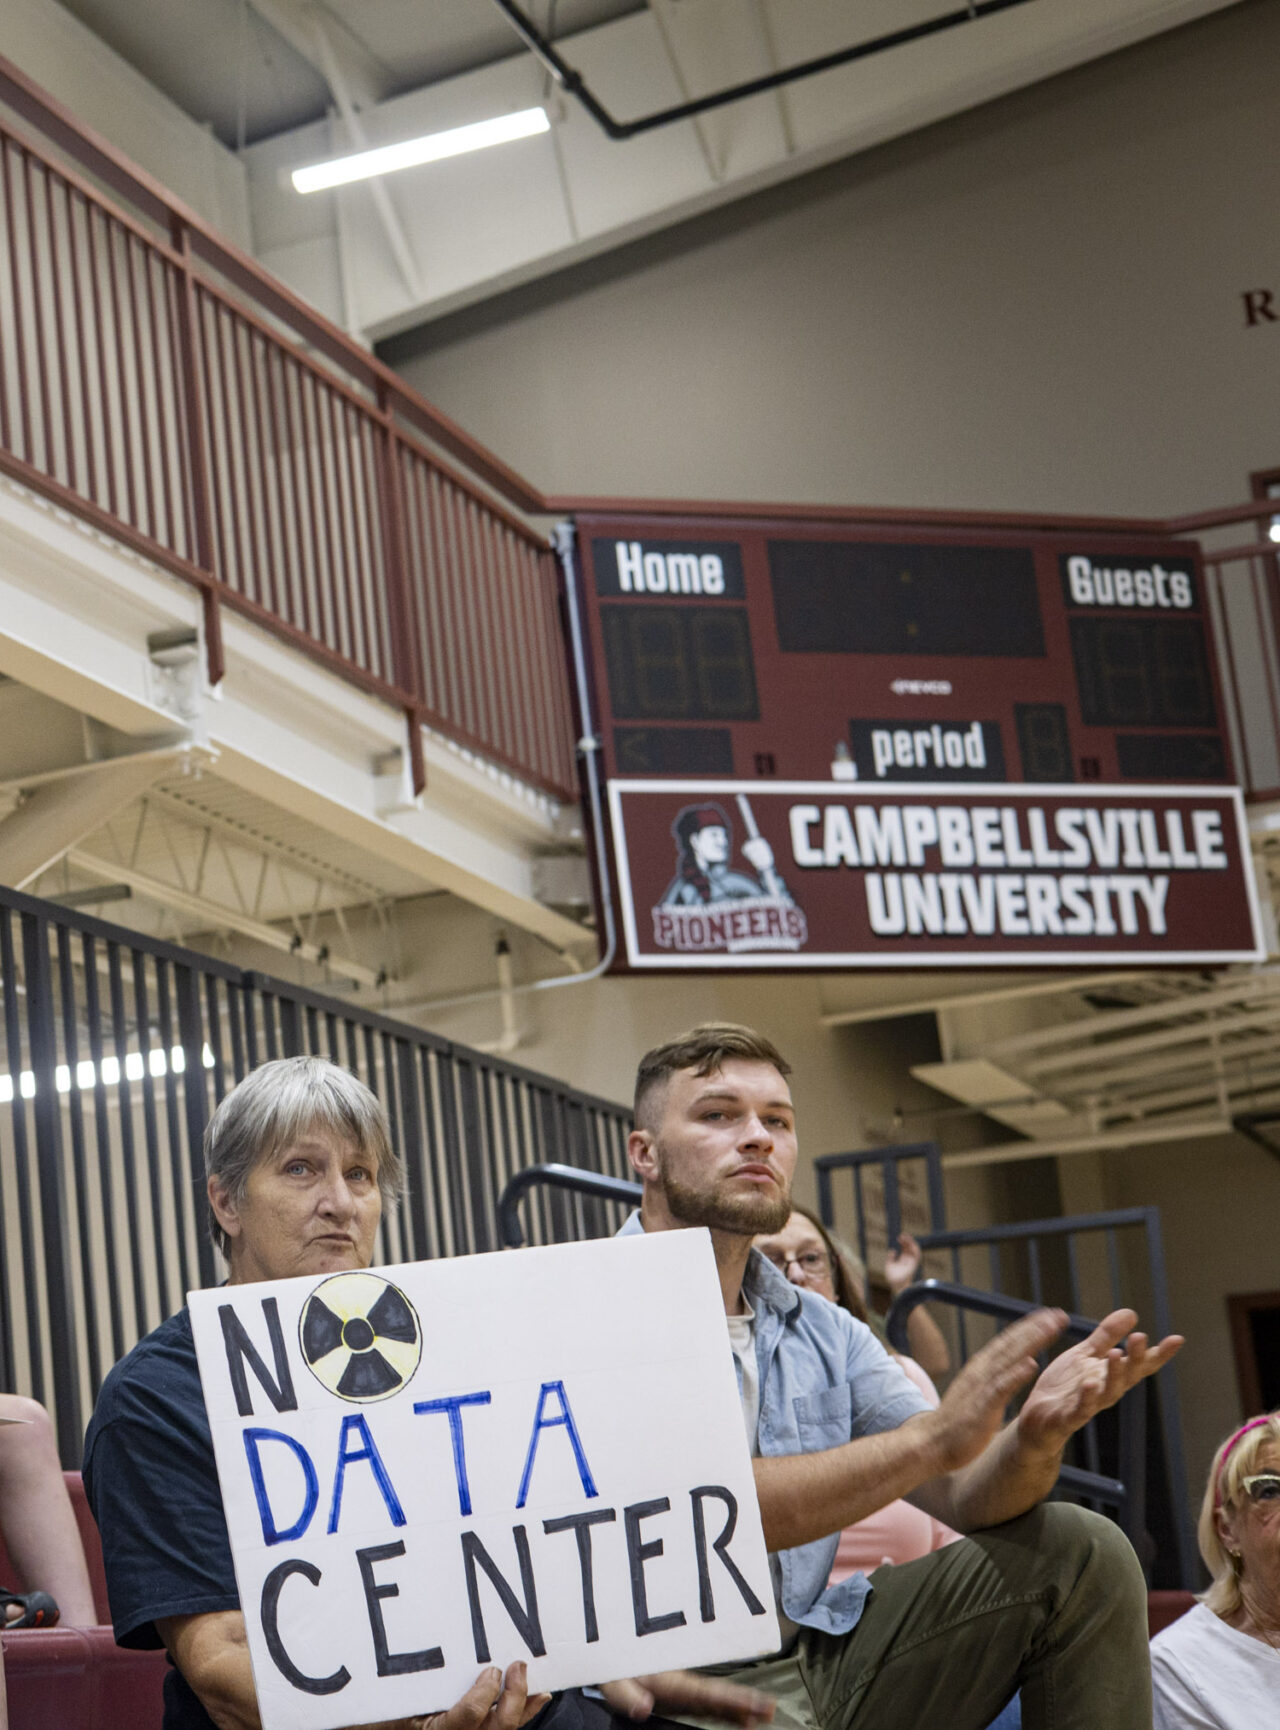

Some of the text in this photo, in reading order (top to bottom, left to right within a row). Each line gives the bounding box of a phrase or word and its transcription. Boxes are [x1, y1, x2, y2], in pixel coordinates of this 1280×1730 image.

[616, 542, 724, 594] Home
[1067, 556, 1192, 608] Guests
[871, 722, 986, 777] period
[788, 805, 1228, 870] CAMPBELLSVILLE
[652, 903, 808, 950] PIONEERS
[865, 874, 1170, 935] UNIVERSITY
[243, 1380, 599, 1546] DATA
[261, 1485, 766, 1696] CENTER
